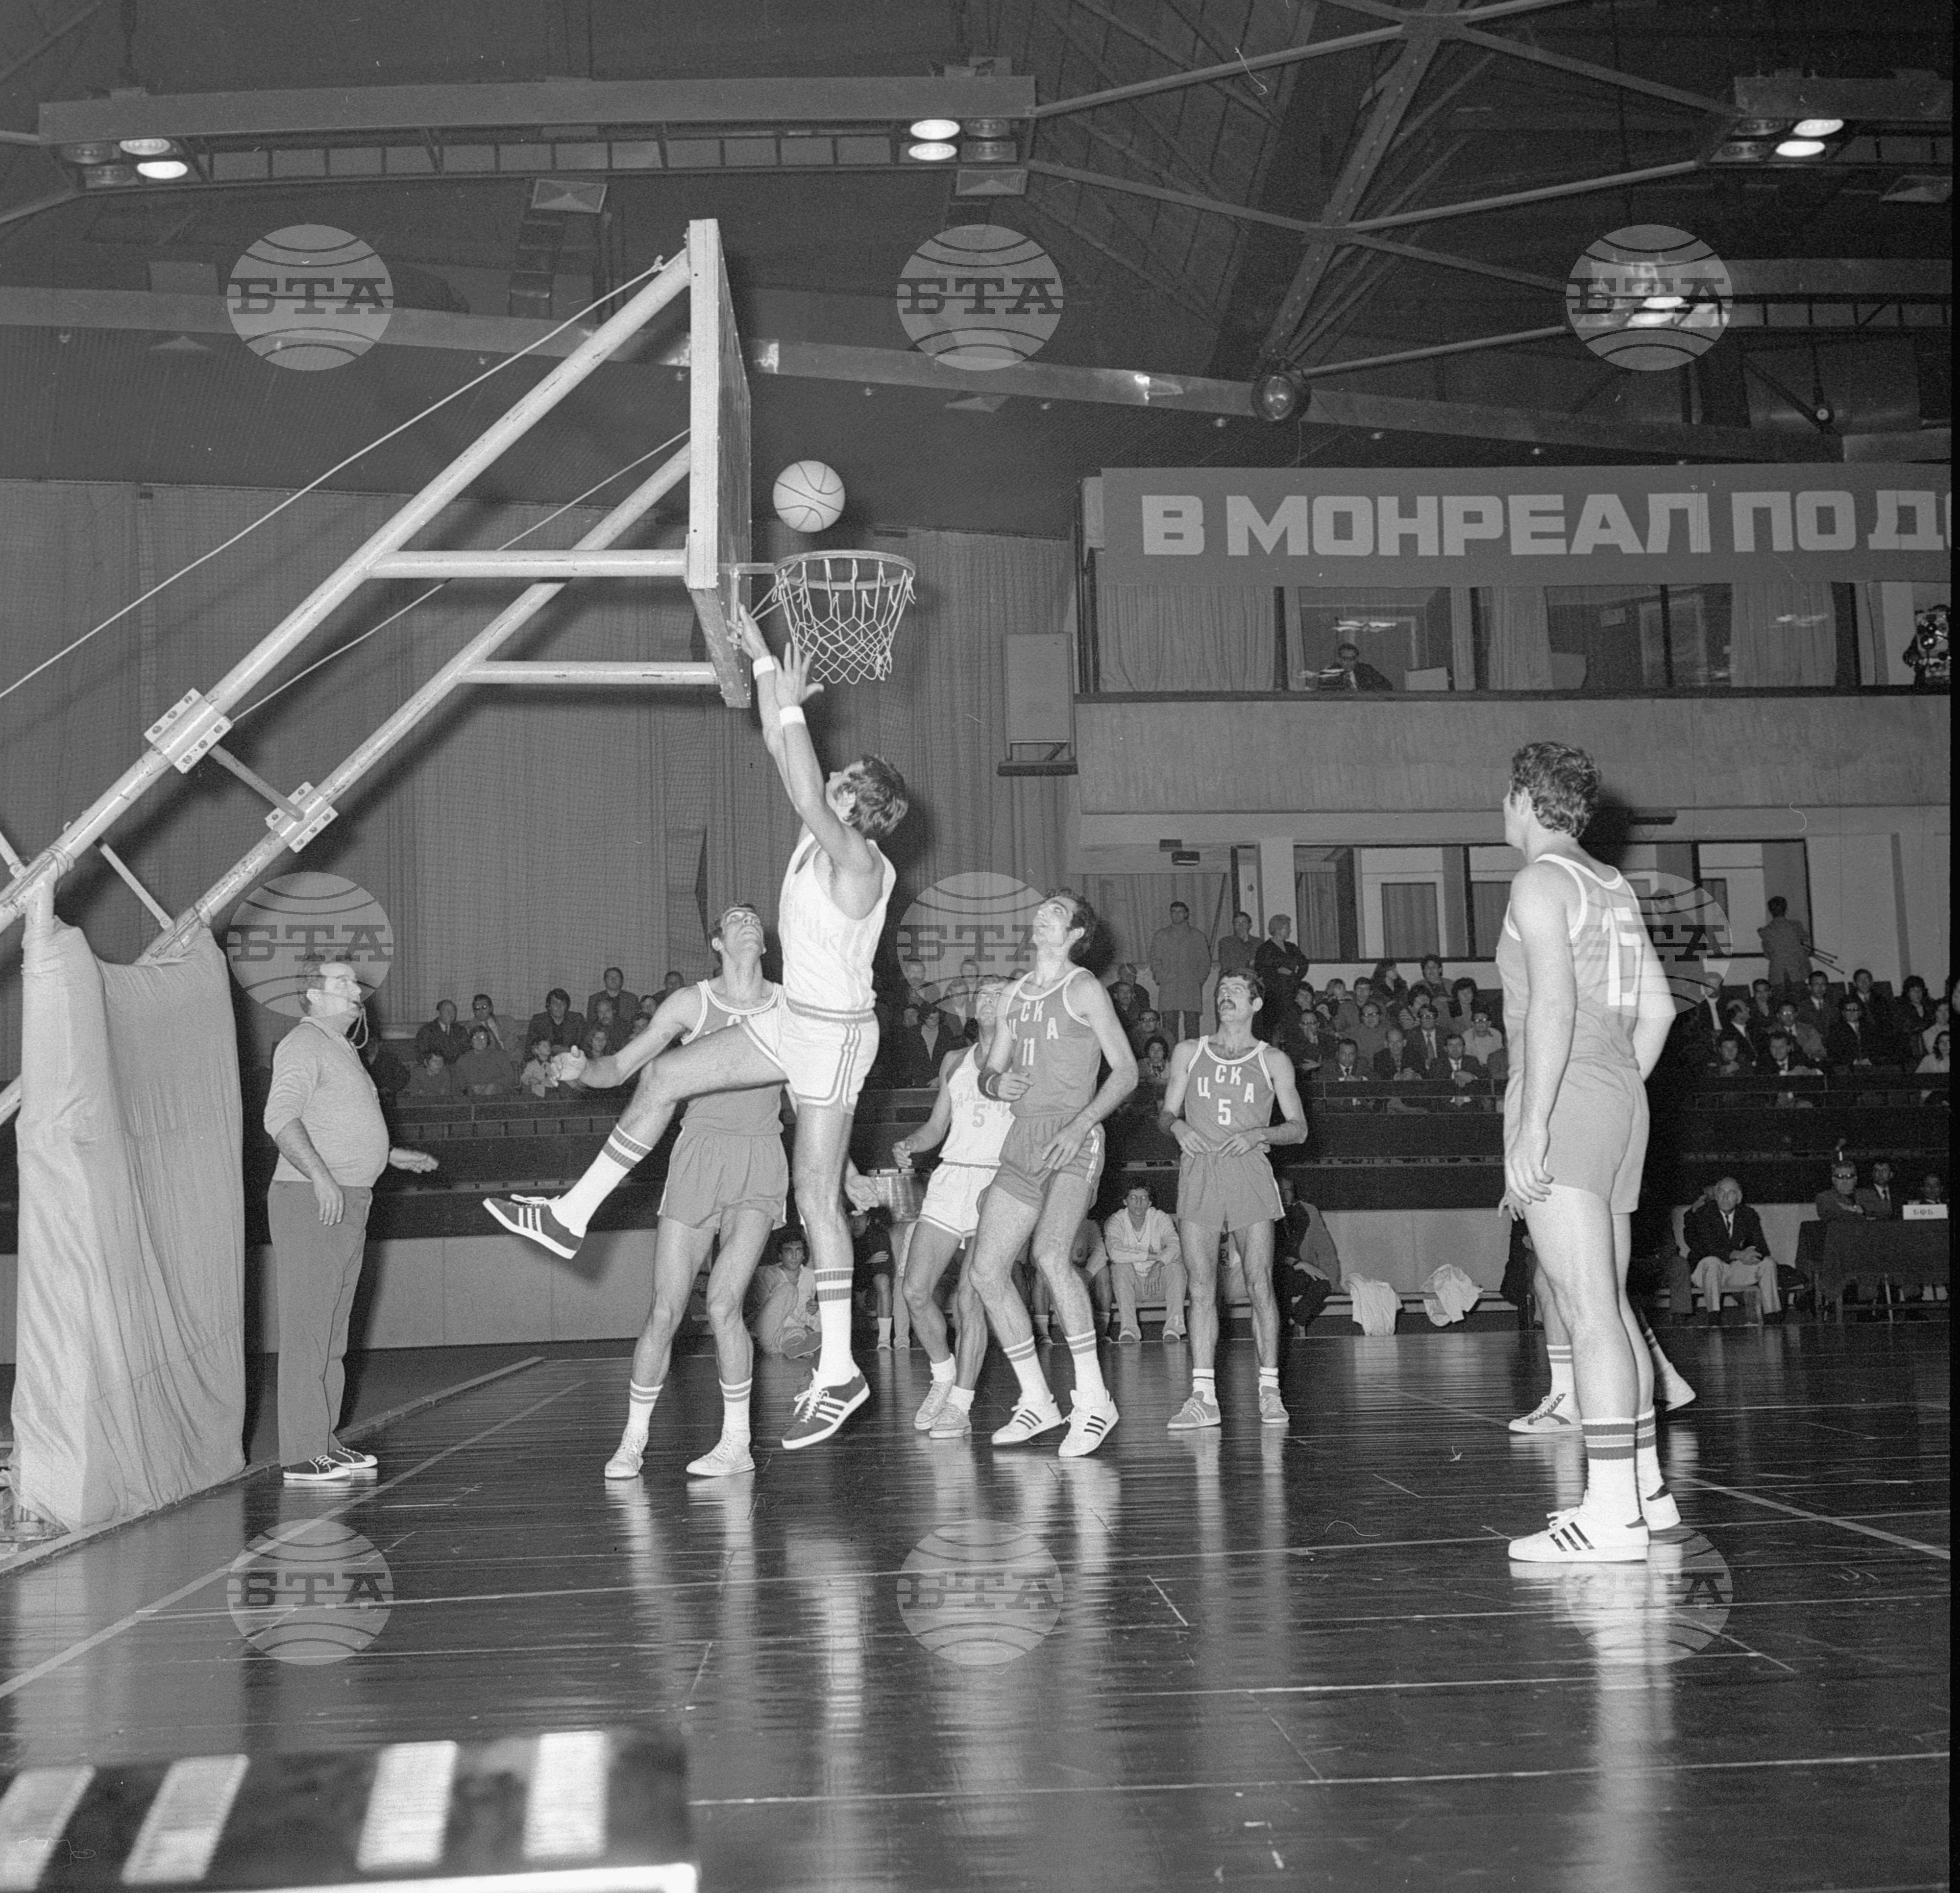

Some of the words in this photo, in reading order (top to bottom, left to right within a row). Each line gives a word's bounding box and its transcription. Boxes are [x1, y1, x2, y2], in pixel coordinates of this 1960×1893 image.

[1142, 495, 1205, 555] В
[1226, 493, 1711, 556] МОНРЕАЛ
[1602, 907, 1642, 1006] 15
[1022, 1037, 1035, 1066] 11
[1198, 1064, 1254, 1103] ЦСКА
[972, 1103, 987, 1128] 5
[1218, 1098, 1231, 1125] 5
